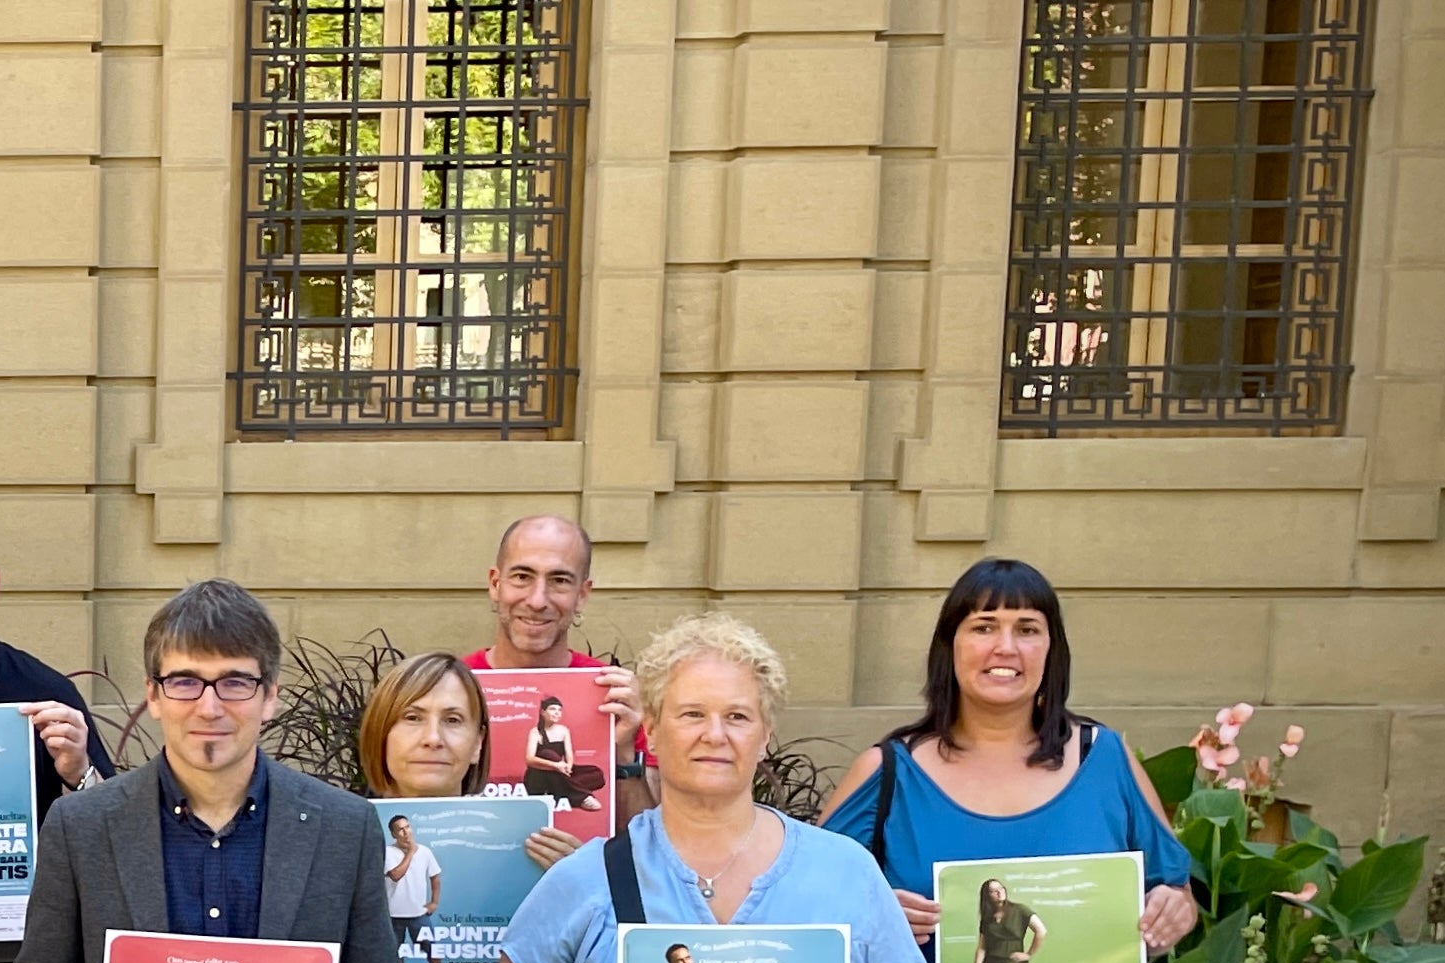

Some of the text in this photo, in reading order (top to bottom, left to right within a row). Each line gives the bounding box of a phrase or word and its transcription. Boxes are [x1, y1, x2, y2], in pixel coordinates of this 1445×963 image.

[483, 783, 528, 796] ORA
[398, 943, 502, 958] AL EUSKE
